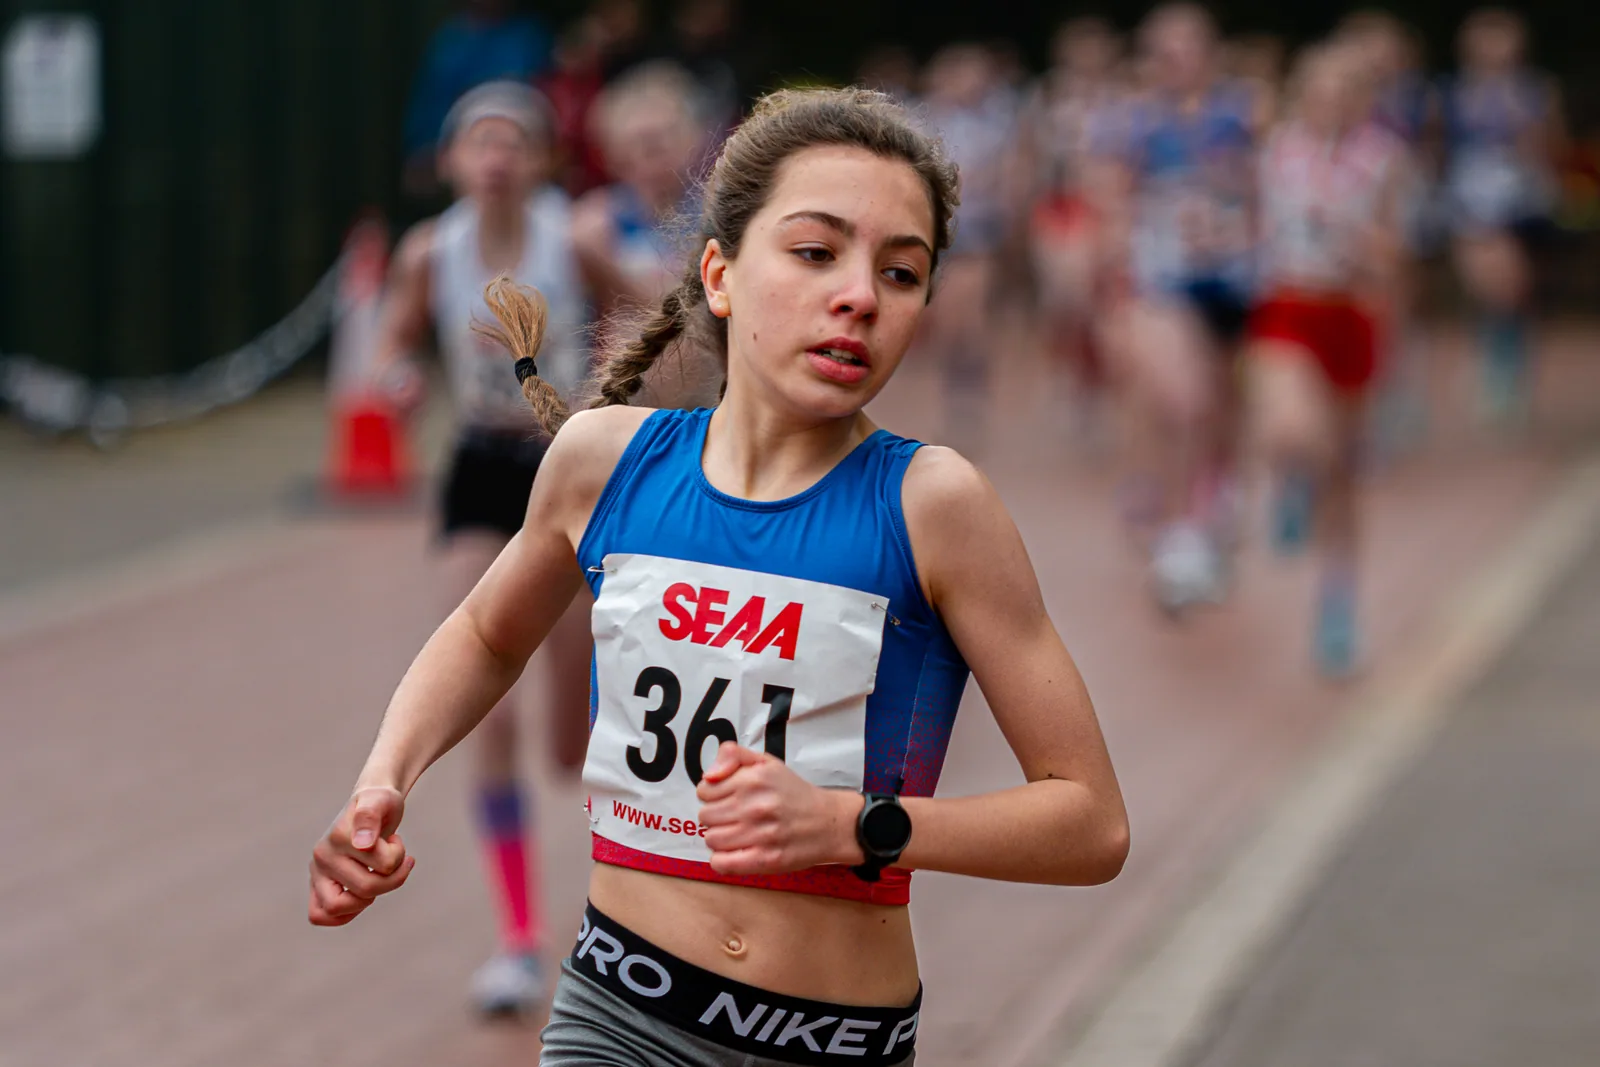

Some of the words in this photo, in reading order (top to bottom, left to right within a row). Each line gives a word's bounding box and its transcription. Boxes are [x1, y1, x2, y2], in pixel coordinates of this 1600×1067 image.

[658, 582, 804, 661] SEAA
[625, 666, 795, 789] 361
[698, 991, 882, 1057] NIKE
